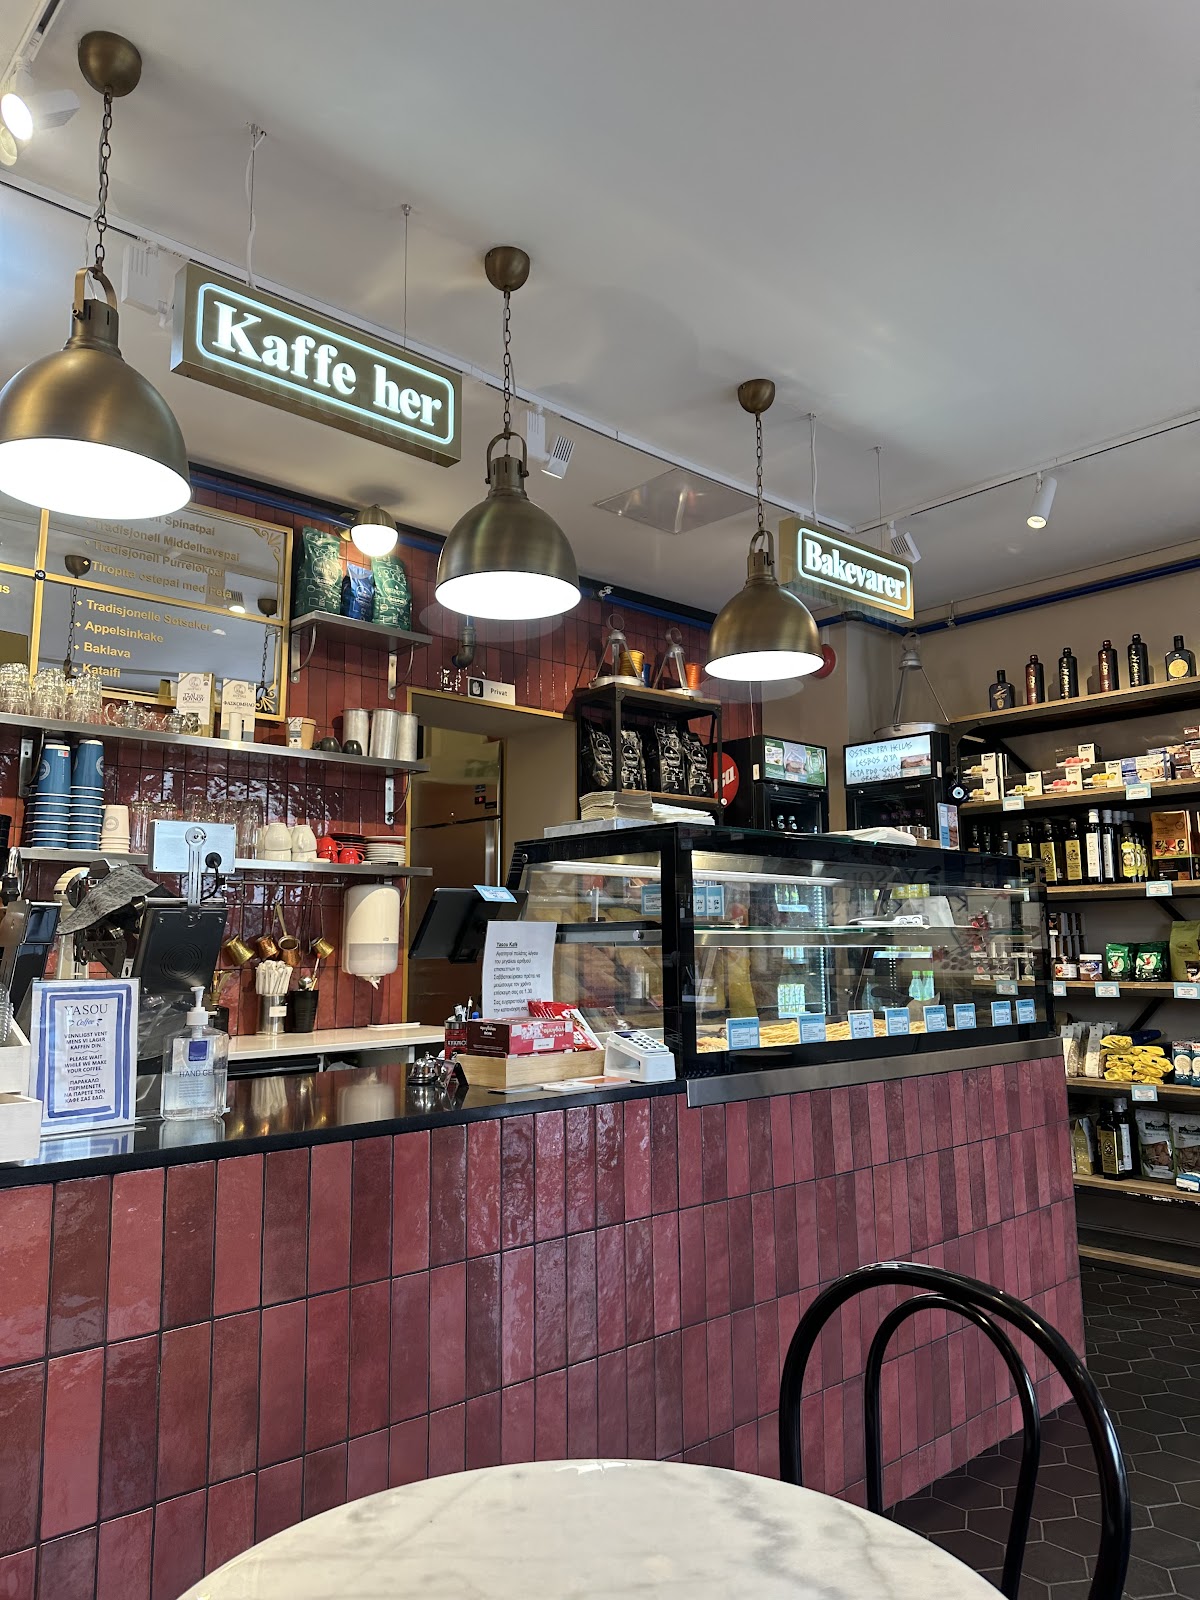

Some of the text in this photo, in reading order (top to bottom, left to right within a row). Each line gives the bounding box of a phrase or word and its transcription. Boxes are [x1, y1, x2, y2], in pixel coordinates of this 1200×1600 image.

[212, 300, 443, 427] Kaffe her
[165, 516, 216, 537] Spinatpai
[95, 519, 240, 562] Tradisjonell Middelhavspai
[93, 540, 160, 564] Tradisjonell
[804, 538, 906, 600] Bakevarer
[92, 560, 232, 600] Tiropita ostepai med Feta
[86, 599, 161, 622] Tradisjonelle
[85, 620, 164, 643] Appelsinkake
[83, 641, 131, 659] Baklava
[82, 663, 121, 678] Kataifi
[490, 687, 508, 697] Privat
[876, 744, 888, 753] FRA
[855, 756, 881, 767] LESBOS
[64, 1003, 109, 1016] YASOU
[76, 1017, 96, 1027] Coffee
[69, 1077, 100, 1085] ΠΑΡΑΚΑΛΩ
[179, 1069, 201, 1078] HAND
[68, 1083, 102, 1091] ΠΕΡΙΜΕΝΕΤΕ
